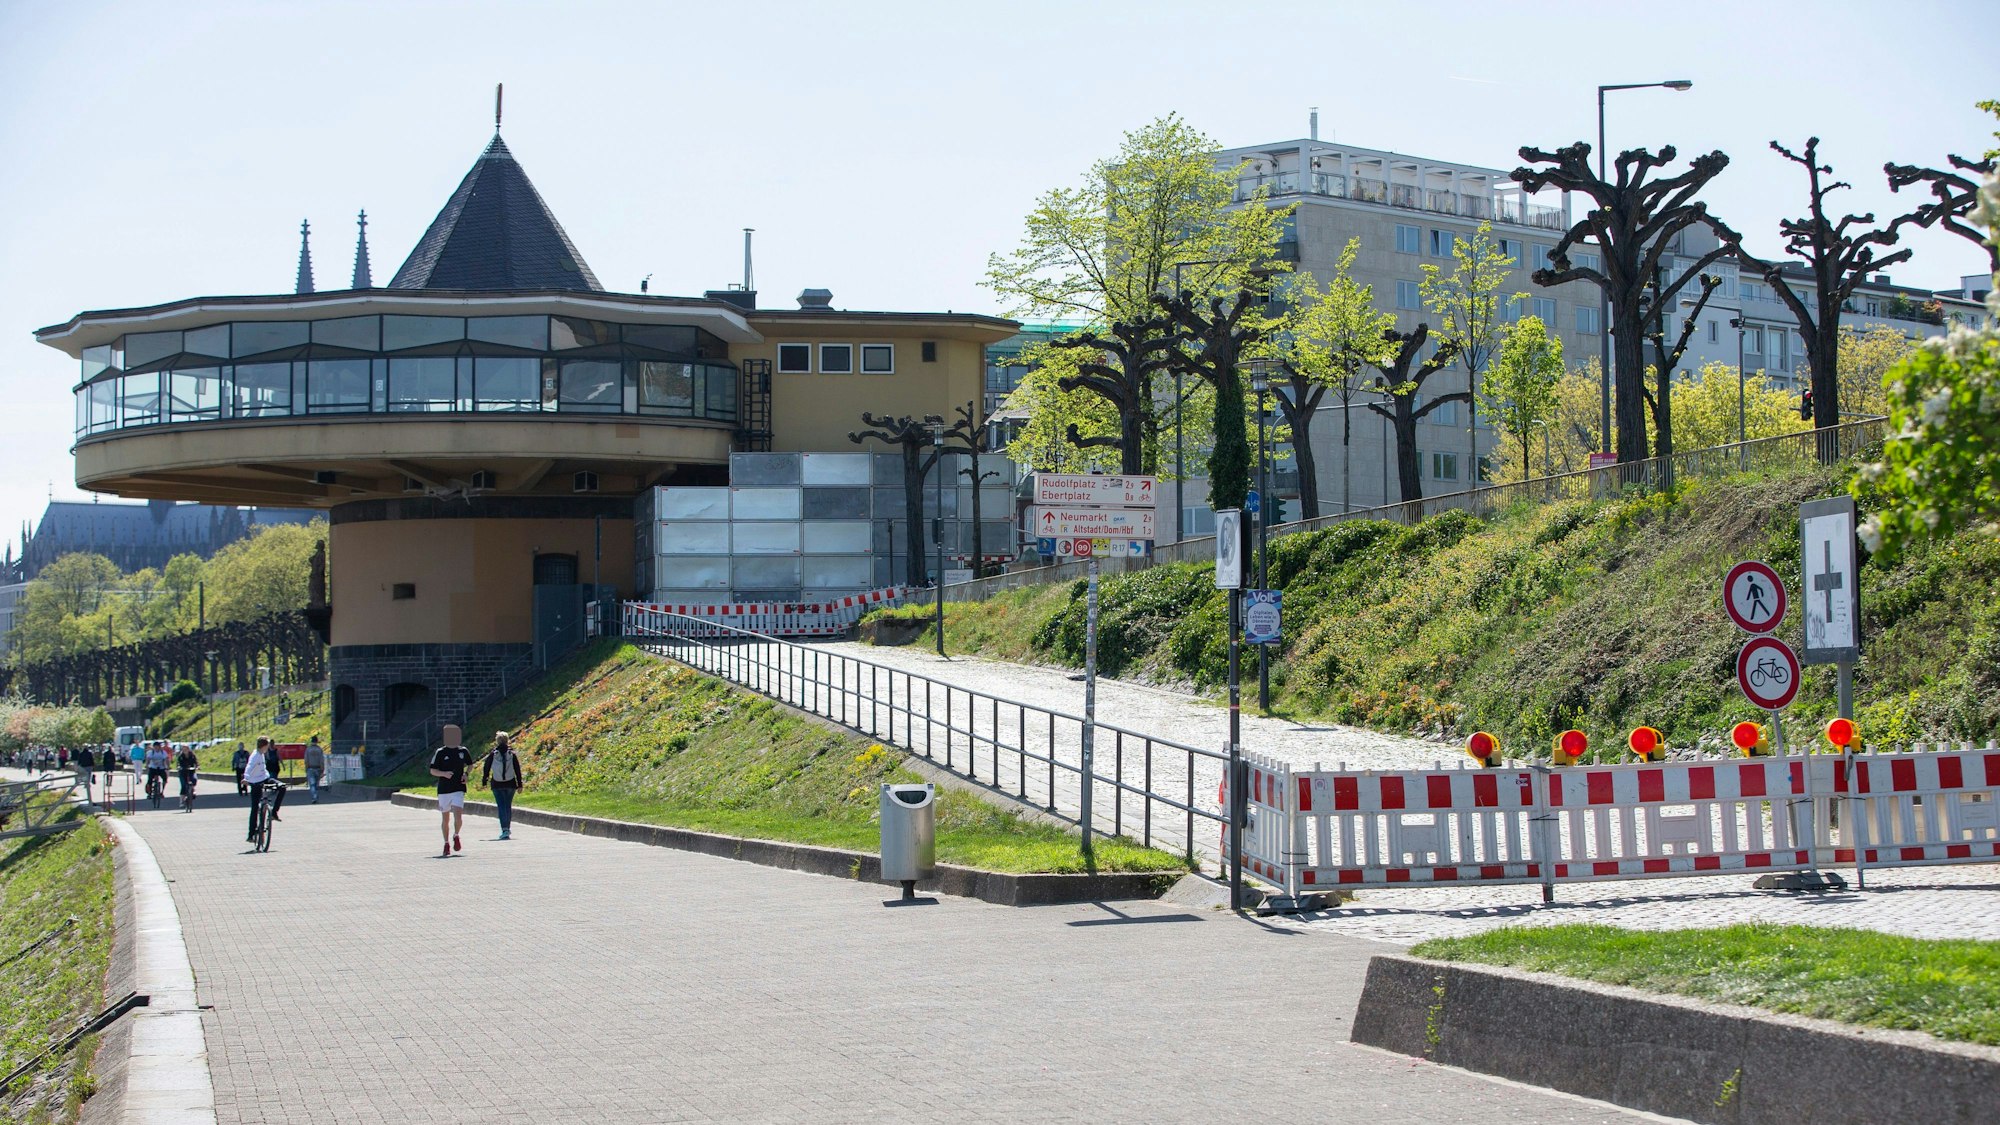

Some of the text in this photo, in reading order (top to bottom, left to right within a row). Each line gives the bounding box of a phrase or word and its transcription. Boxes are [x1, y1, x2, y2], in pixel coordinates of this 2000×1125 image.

[1042, 479, 1096, 489] Rudolfplatz
[1042, 491, 1091, 501] Ebertplatz
[1060, 513, 1107, 522] Neumarkt
[1073, 525, 1134, 534] Altstadt/Dom/Hbf
[1112, 544, 1125, 552] R 17
[1252, 592, 1275, 602] Volt
